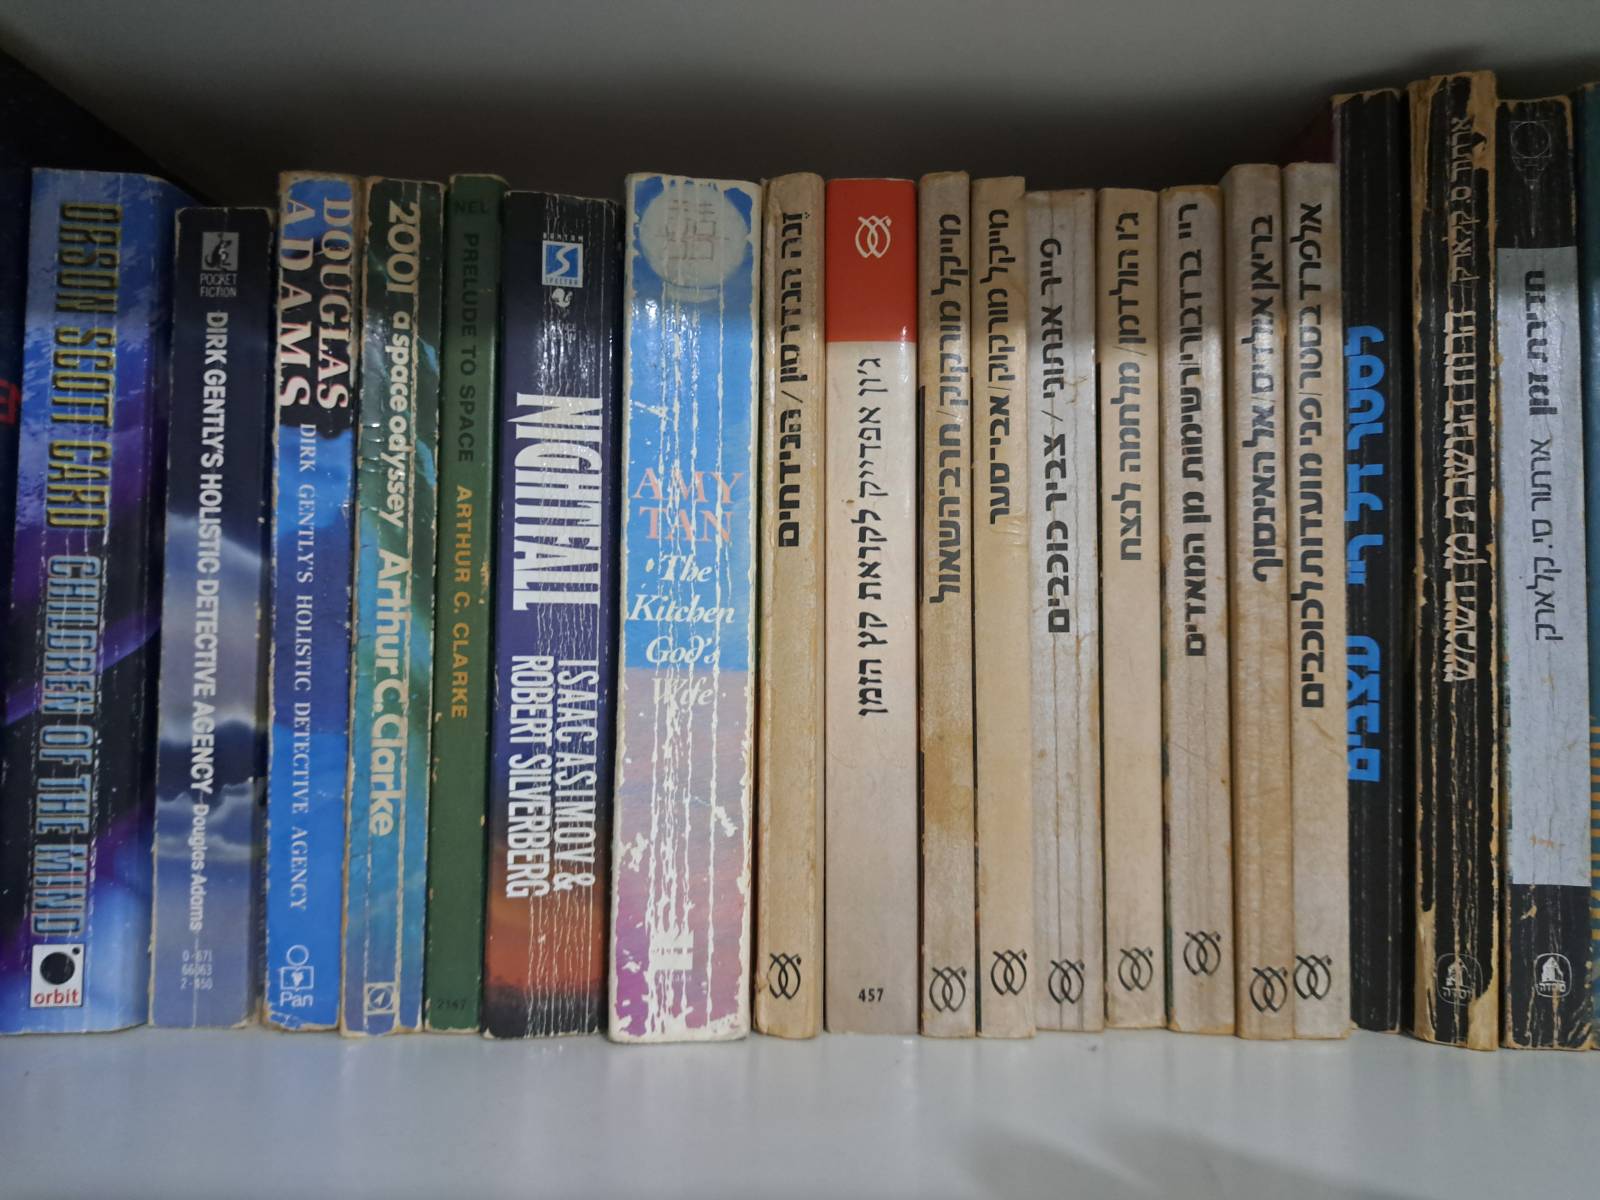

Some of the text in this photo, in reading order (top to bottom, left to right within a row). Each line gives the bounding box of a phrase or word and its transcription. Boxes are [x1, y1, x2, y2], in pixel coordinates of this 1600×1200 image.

[931, 213, 969, 296] מייקל
[980, 208, 1015, 284] מייקל
[1039, 238, 1063, 296] פייר
[1178, 202, 1198, 240] ריי
[1250, 214, 1280, 290] בריאן
[1290, 202, 1322, 300] אלפרד
[200, 273, 238, 286] POCKET
[200, 286, 237, 298] FICTION
[279, 197, 316, 407] ADAMS
[315, 197, 353, 410] DOUGLAS
[46, 203, 122, 531] ORSON SCOTT CARD
[379, 200, 422, 529] 2001 a space odyssey
[458, 233, 480, 462] PRELUDE TO SPACE
[1040, 305, 1065, 398] אנתוני
[1524, 270, 1558, 416] חדירת זמן
[857, 406, 889, 498] אפדייק
[1042, 434, 1068, 512] צביר
[1111, 362, 1142, 472] מלחמה
[506, 391, 603, 611] NIGHTFALL
[630, 466, 744, 504] AMY
[639, 506, 736, 543] TAN
[778, 409, 803, 548] הנידחים
[1112, 482, 1142, 561] לנצח
[1182, 491, 1211, 523] מן
[1252, 451, 1284, 582] האינסוף
[1299, 453, 1324, 576] מועדות
[1442, 310, 1487, 682] הרוח הנושבת מן השמש
[1529, 438, 1552, 511] ארתור
[190, 311, 229, 795] DIRK GENTLY'S HOLISTIC DETECTIVE AGENCY
[451, 485, 474, 719] ARTHUR C. CLARKE
[628, 594, 736, 624] Kitchen
[659, 553, 713, 582] The
[1044, 519, 1070, 634] כוכבים
[1182, 532, 1207, 656] המאדים
[1526, 556, 1563, 641] קלארק
[290, 423, 317, 911] DIRK GENTLY'S HOLISTIC DETECTIVE AGENCY
[376, 550, 411, 675] Arthur
[851, 508, 889, 717] לקראת קץ הזמן
[1290, 581, 1324, 708] לכוכבים
[31, 554, 101, 937] CHILDREN OF THE MIND
[652, 676, 714, 706] Wife
[1345, 635, 1381, 783] עצבים
[505, 655, 554, 898] ROBERT SILVERBERG
[552, 659, 599, 892] ISAAC ASIMOV &
[187, 804, 210, 931] Douglas Adams
[33, 987, 79, 1005] orbit
[280, 991, 313, 1007] Pan
[858, 988, 884, 1002] 457
